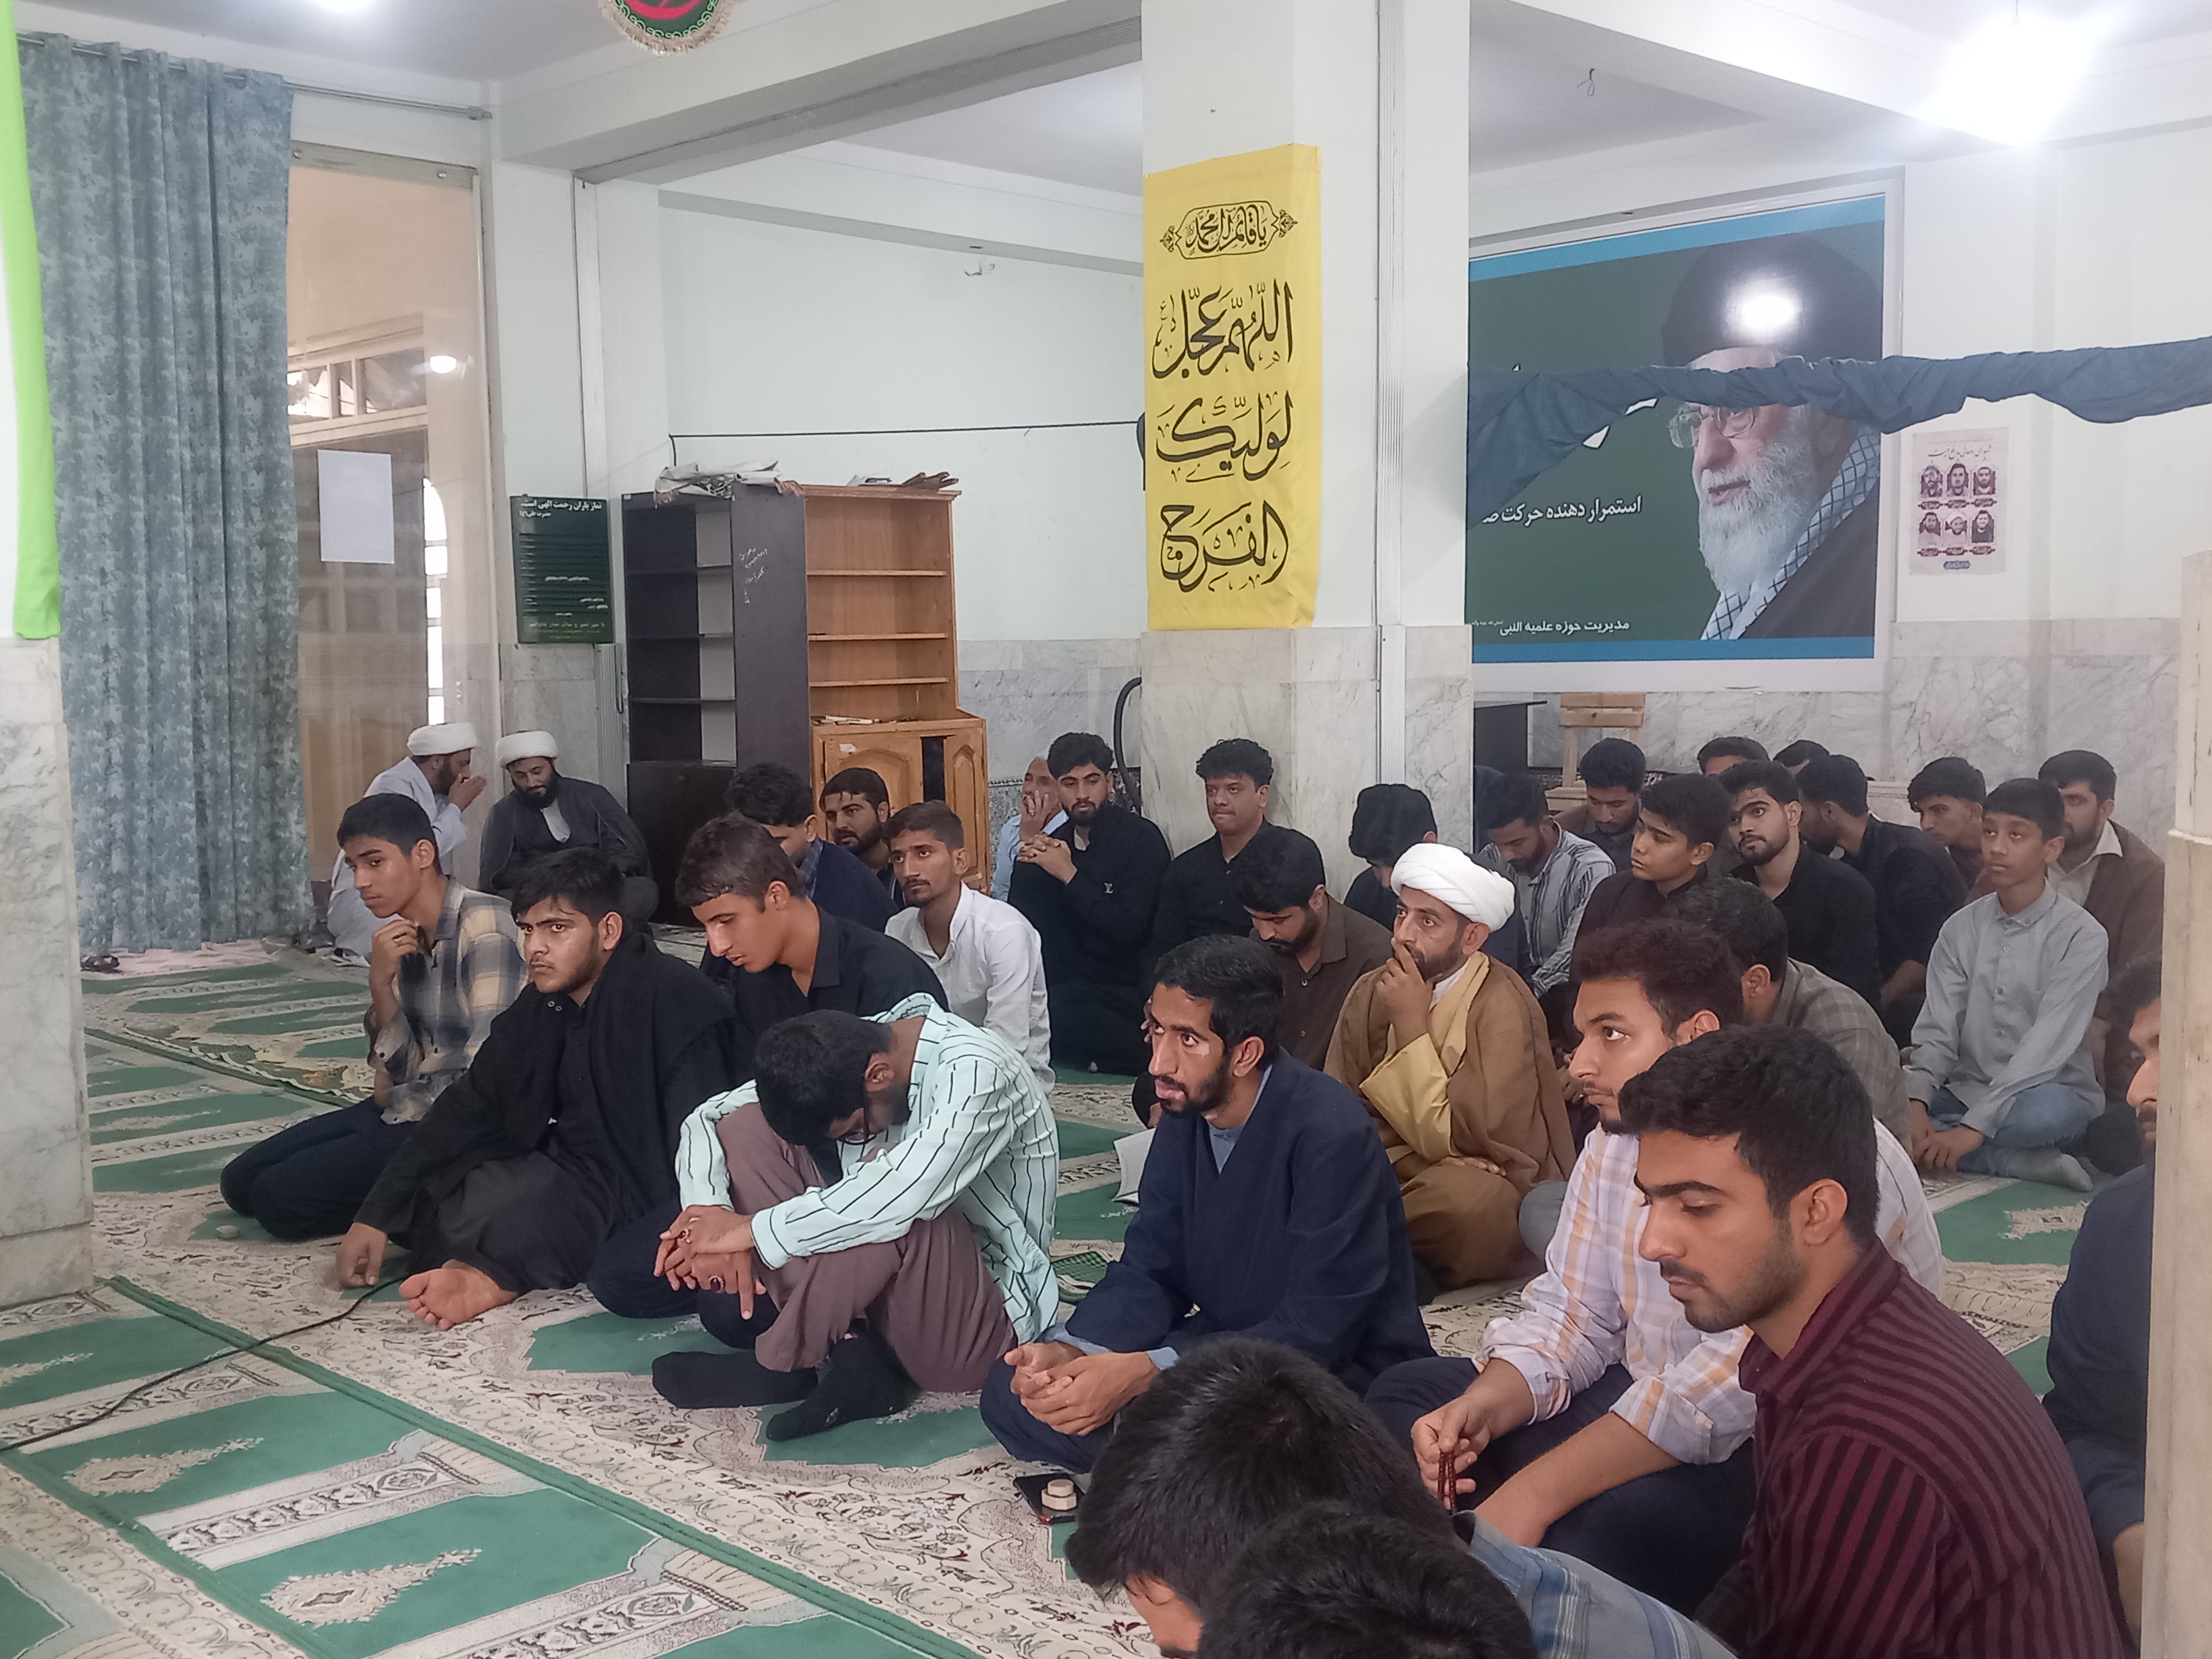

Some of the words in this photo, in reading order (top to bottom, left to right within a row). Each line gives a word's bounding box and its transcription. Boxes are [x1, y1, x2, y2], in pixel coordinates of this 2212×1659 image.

[1501, 502, 1544, 527] حرکت
[1546, 502, 1586, 519] دهنده
[1586, 494, 1643, 522] استمرار
[1160, 499, 1289, 593] الفرج
[1524, 620, 1554, 635] علمیه
[1555, 622, 1581, 635] حوزه
[1584, 621, 1630, 634] مدیریت
